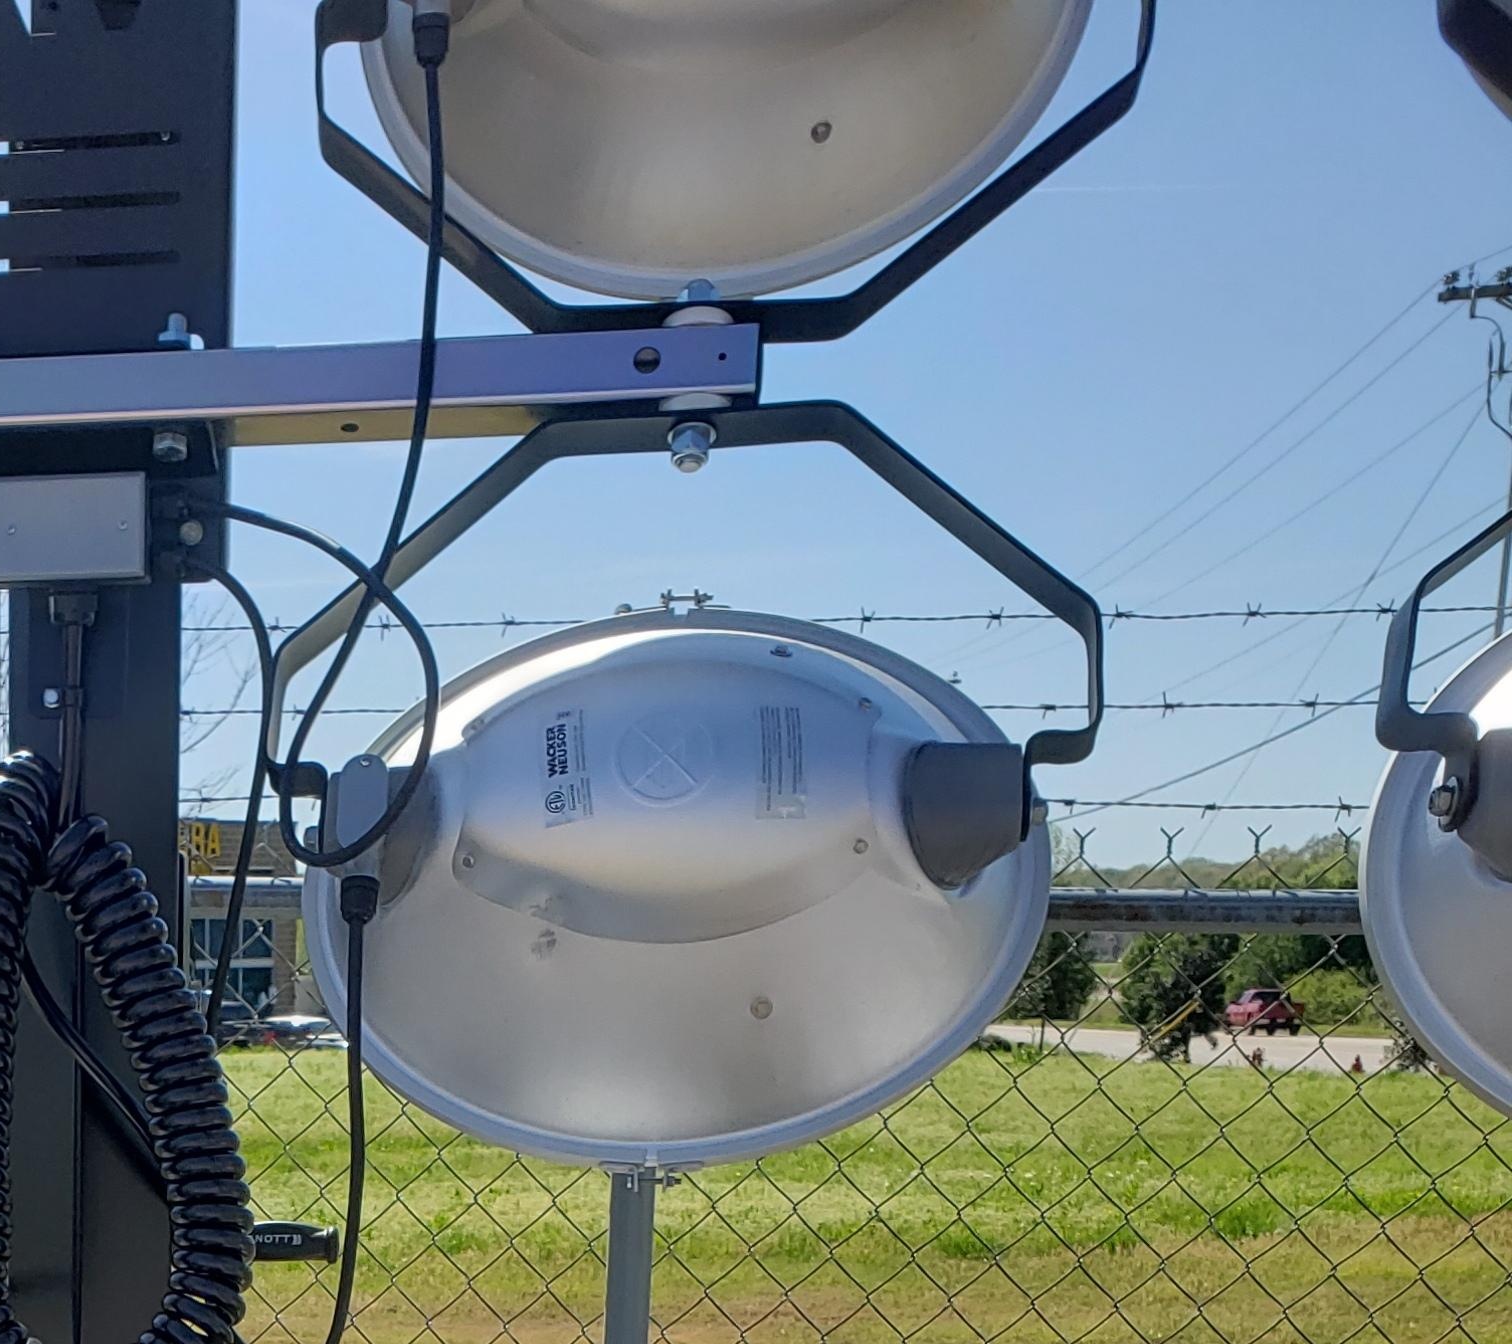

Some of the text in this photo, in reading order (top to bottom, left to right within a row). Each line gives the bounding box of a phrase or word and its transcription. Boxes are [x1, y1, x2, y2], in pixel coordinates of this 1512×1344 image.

[547, 727, 558, 778] WACKER
[556, 723, 569, 775] NEUSON
[252, 1234, 291, 1244] NOTT
